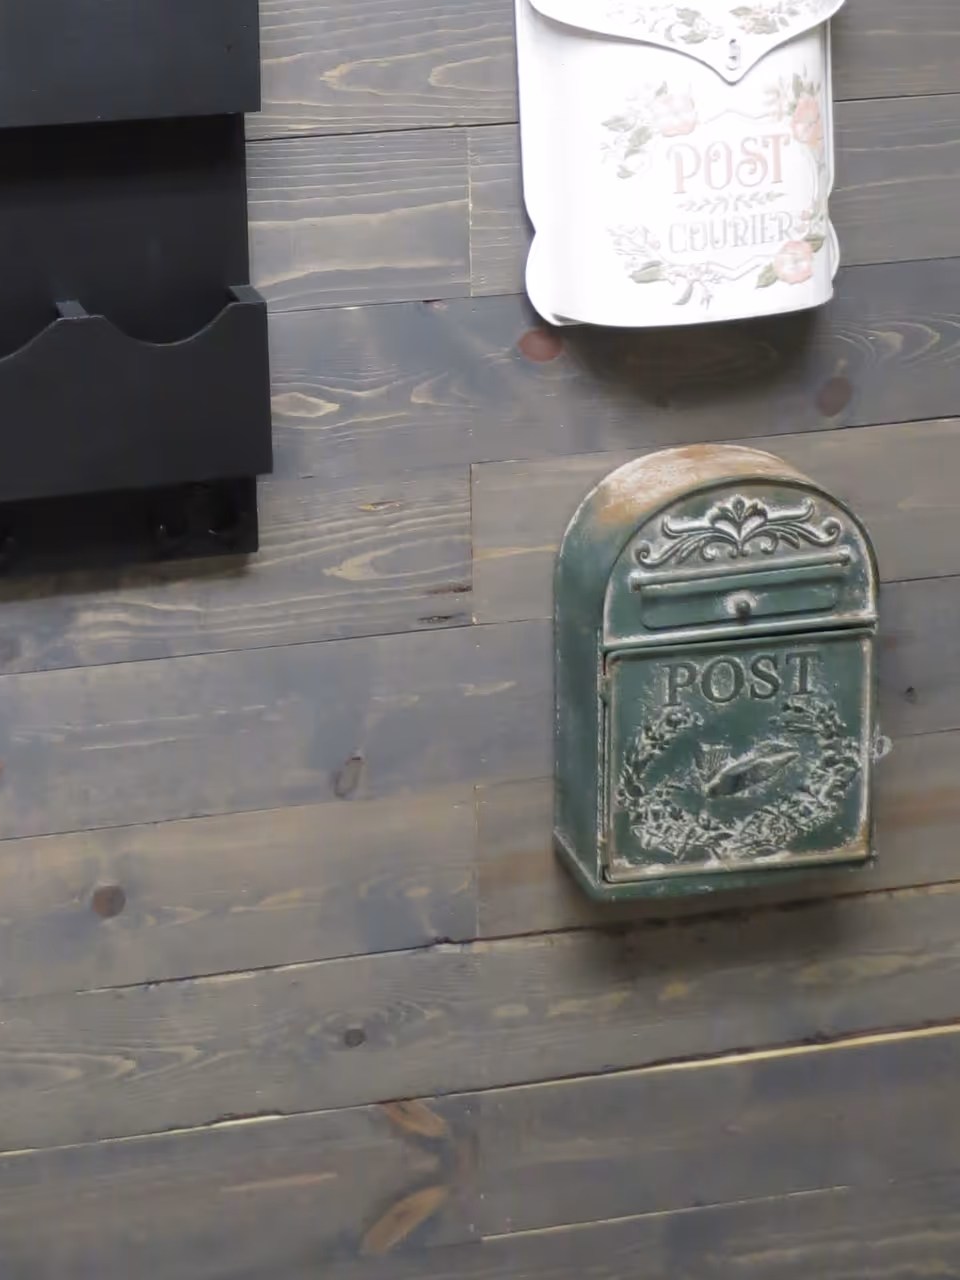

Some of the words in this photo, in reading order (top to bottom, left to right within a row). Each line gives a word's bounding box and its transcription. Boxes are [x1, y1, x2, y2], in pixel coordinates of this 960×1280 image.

[666, 132, 795, 195] POST
[668, 209, 797, 254] COURIER
[662, 650, 823, 708] POST
